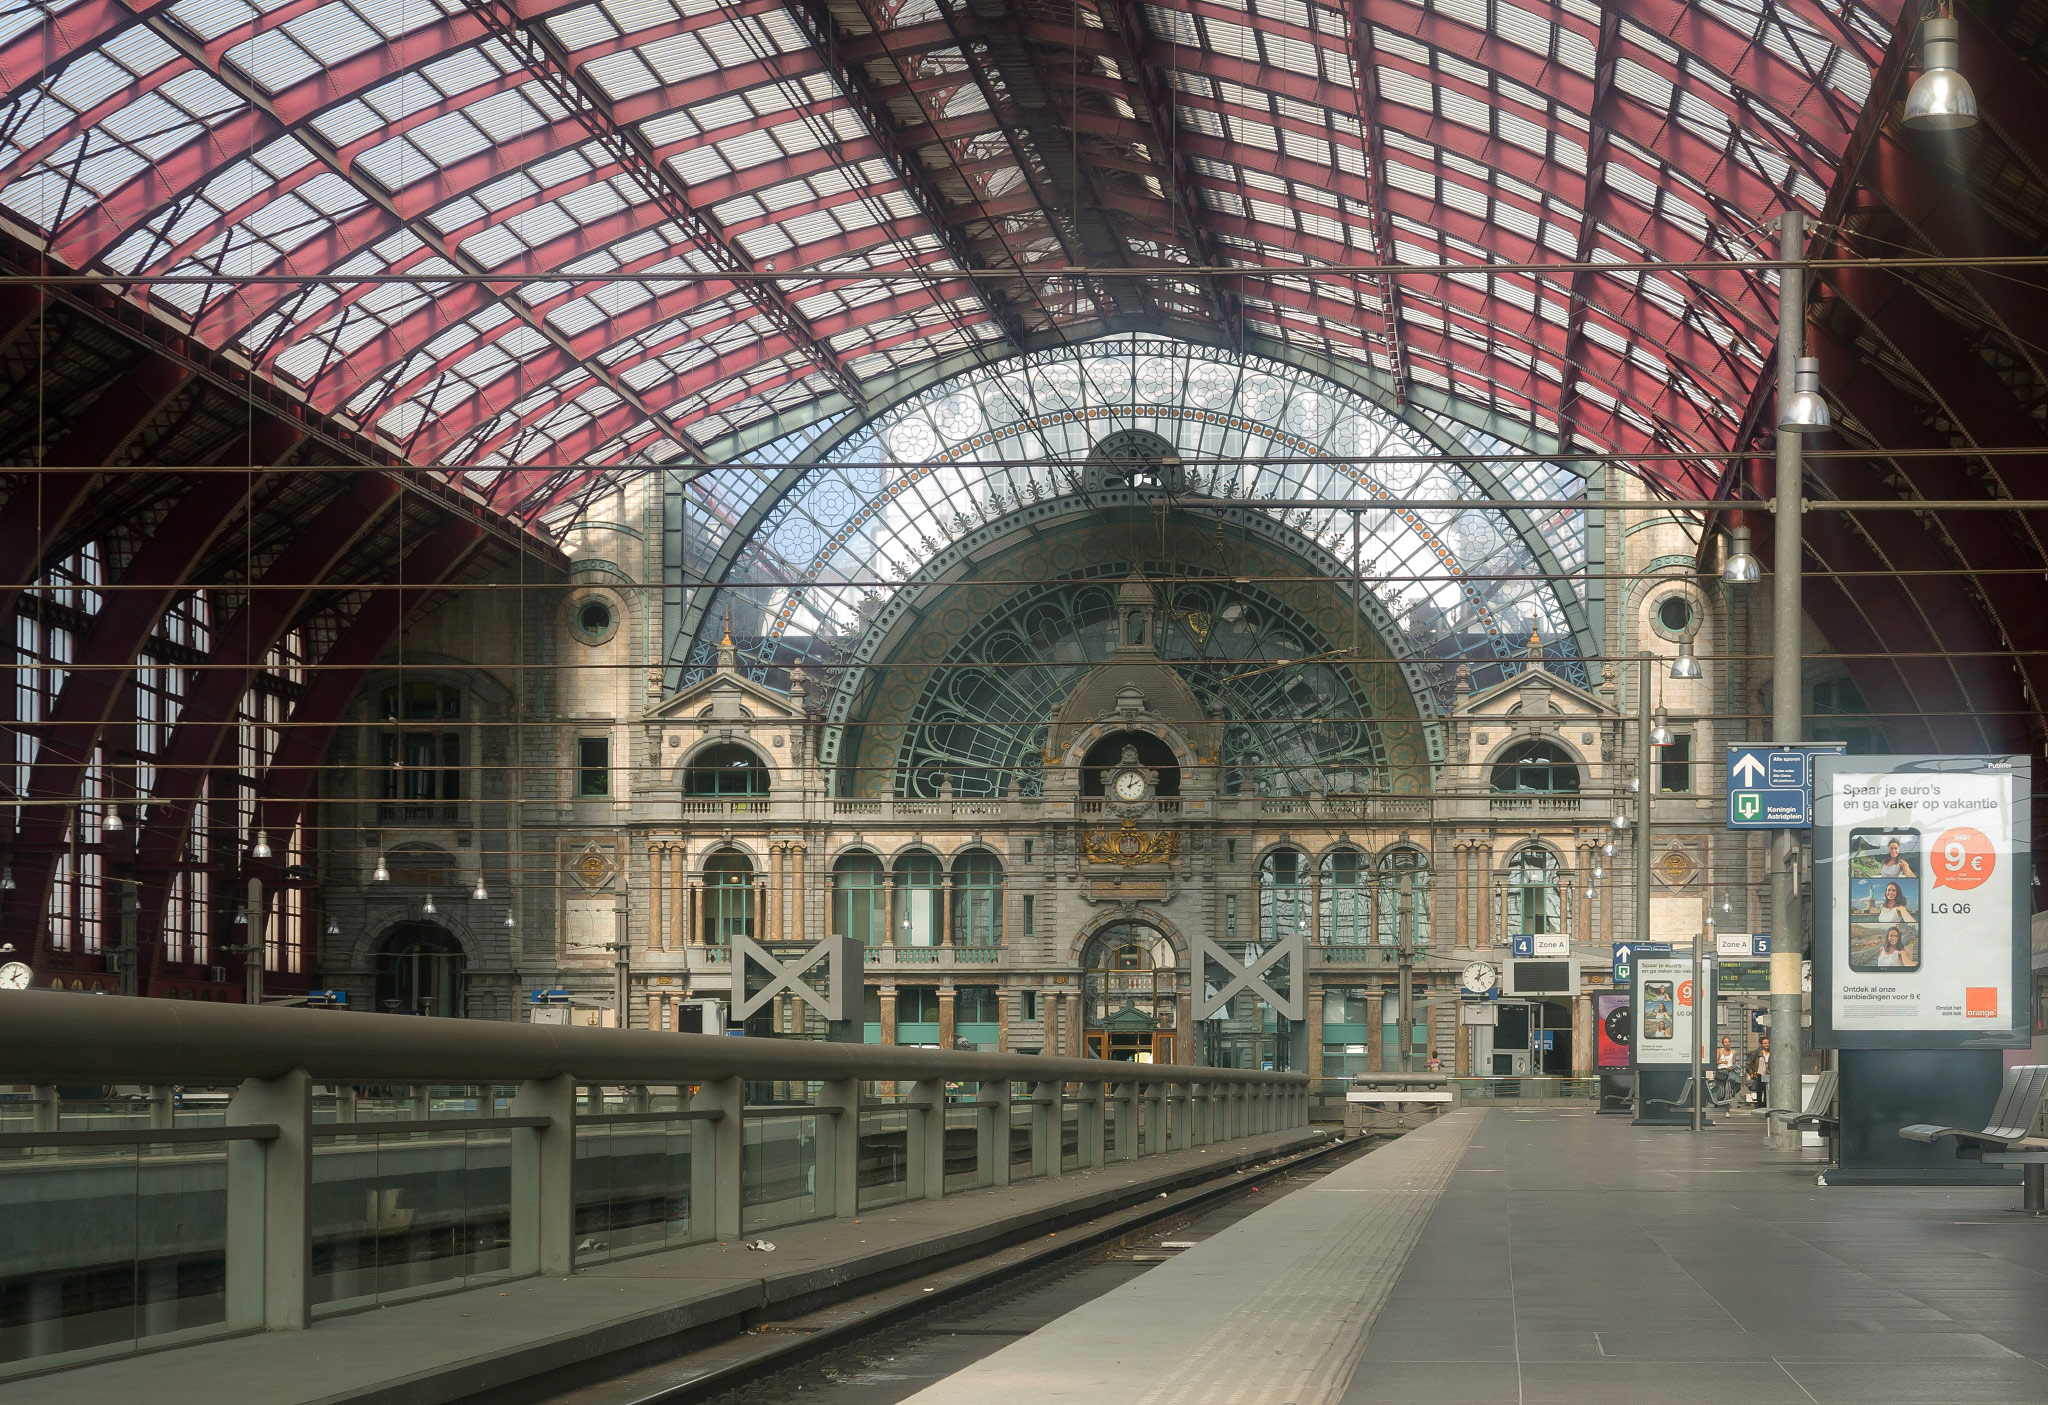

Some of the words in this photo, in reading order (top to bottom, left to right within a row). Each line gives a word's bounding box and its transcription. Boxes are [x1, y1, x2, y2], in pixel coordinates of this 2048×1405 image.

[1843, 784, 1881, 797] Spaar
[1884, 784, 1897, 796] je
[1900, 784, 1941, 796] euro's
[1843, 801, 1859, 809] en
[1863, 801, 1879, 810] ga
[1883, 799, 1918, 809] vaker
[1922, 801, 1940, 811] op
[1944, 798, 1998, 809] vakantie
[1944, 842, 1966, 872] 9
[1970, 856, 1983, 871] €
[1931, 903, 1948, 914] LG
[1952, 903, 1971, 914] Q6
[1519, 941, 1527, 952] 4
[1759, 941, 1767, 952] 5
